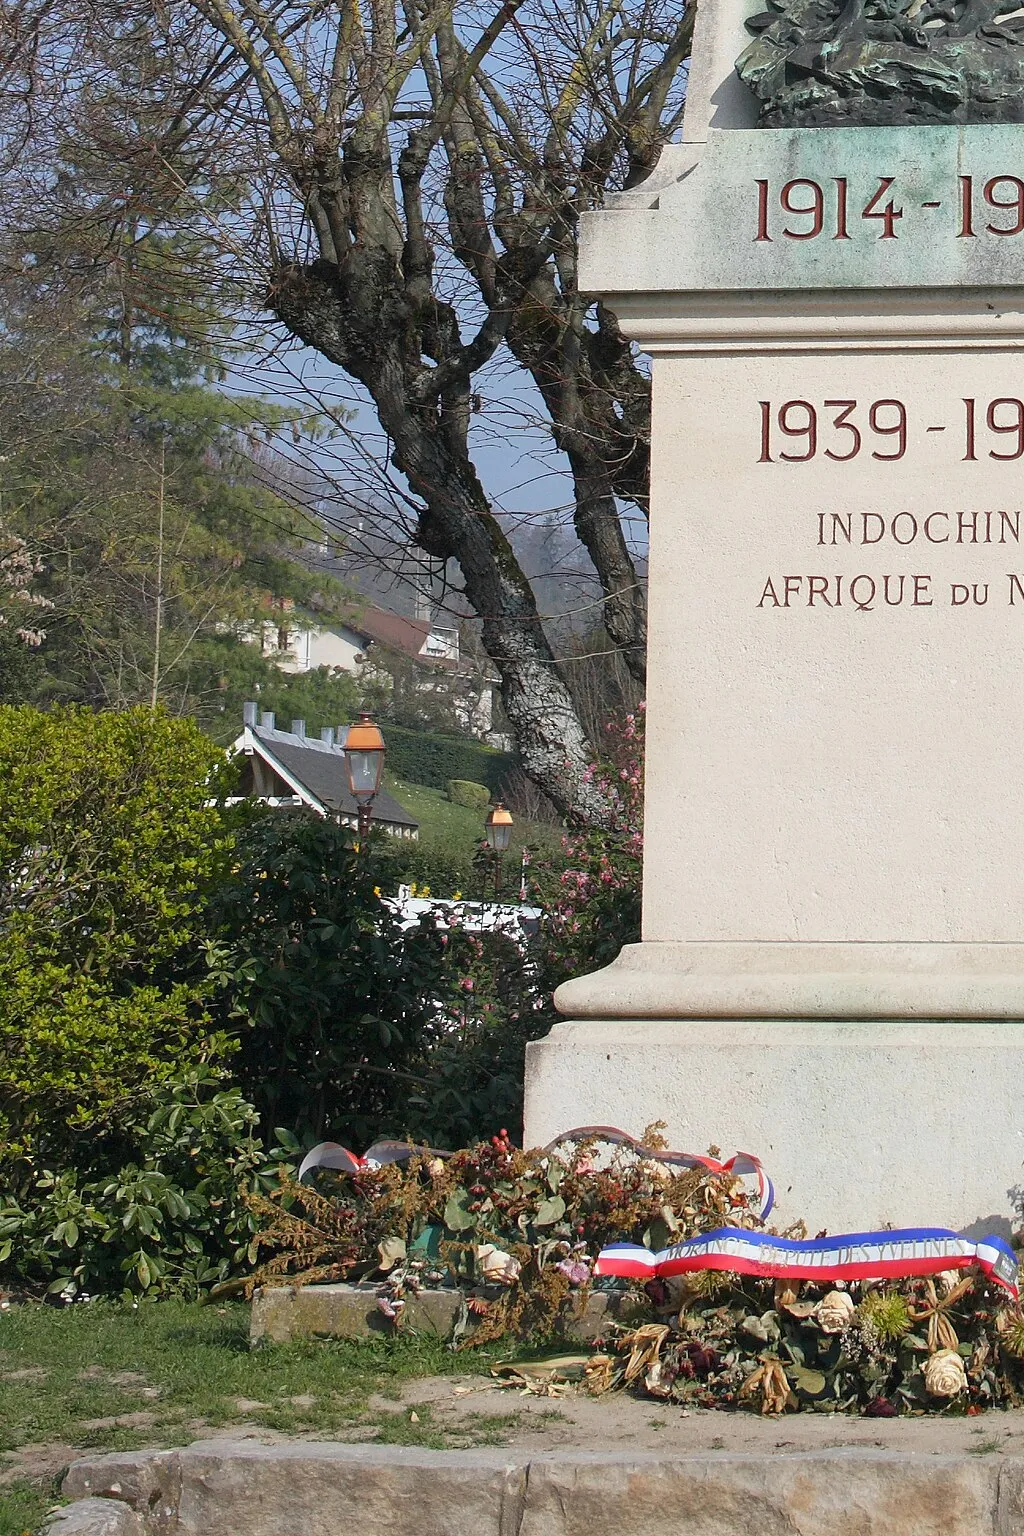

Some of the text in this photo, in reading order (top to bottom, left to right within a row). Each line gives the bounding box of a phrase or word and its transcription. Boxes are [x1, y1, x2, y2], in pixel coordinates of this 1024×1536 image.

[755, 574, 933, 611] AFRIQUE
[838, 1242, 872, 1266] DES
[877, 1236, 967, 1262] YVELINES
